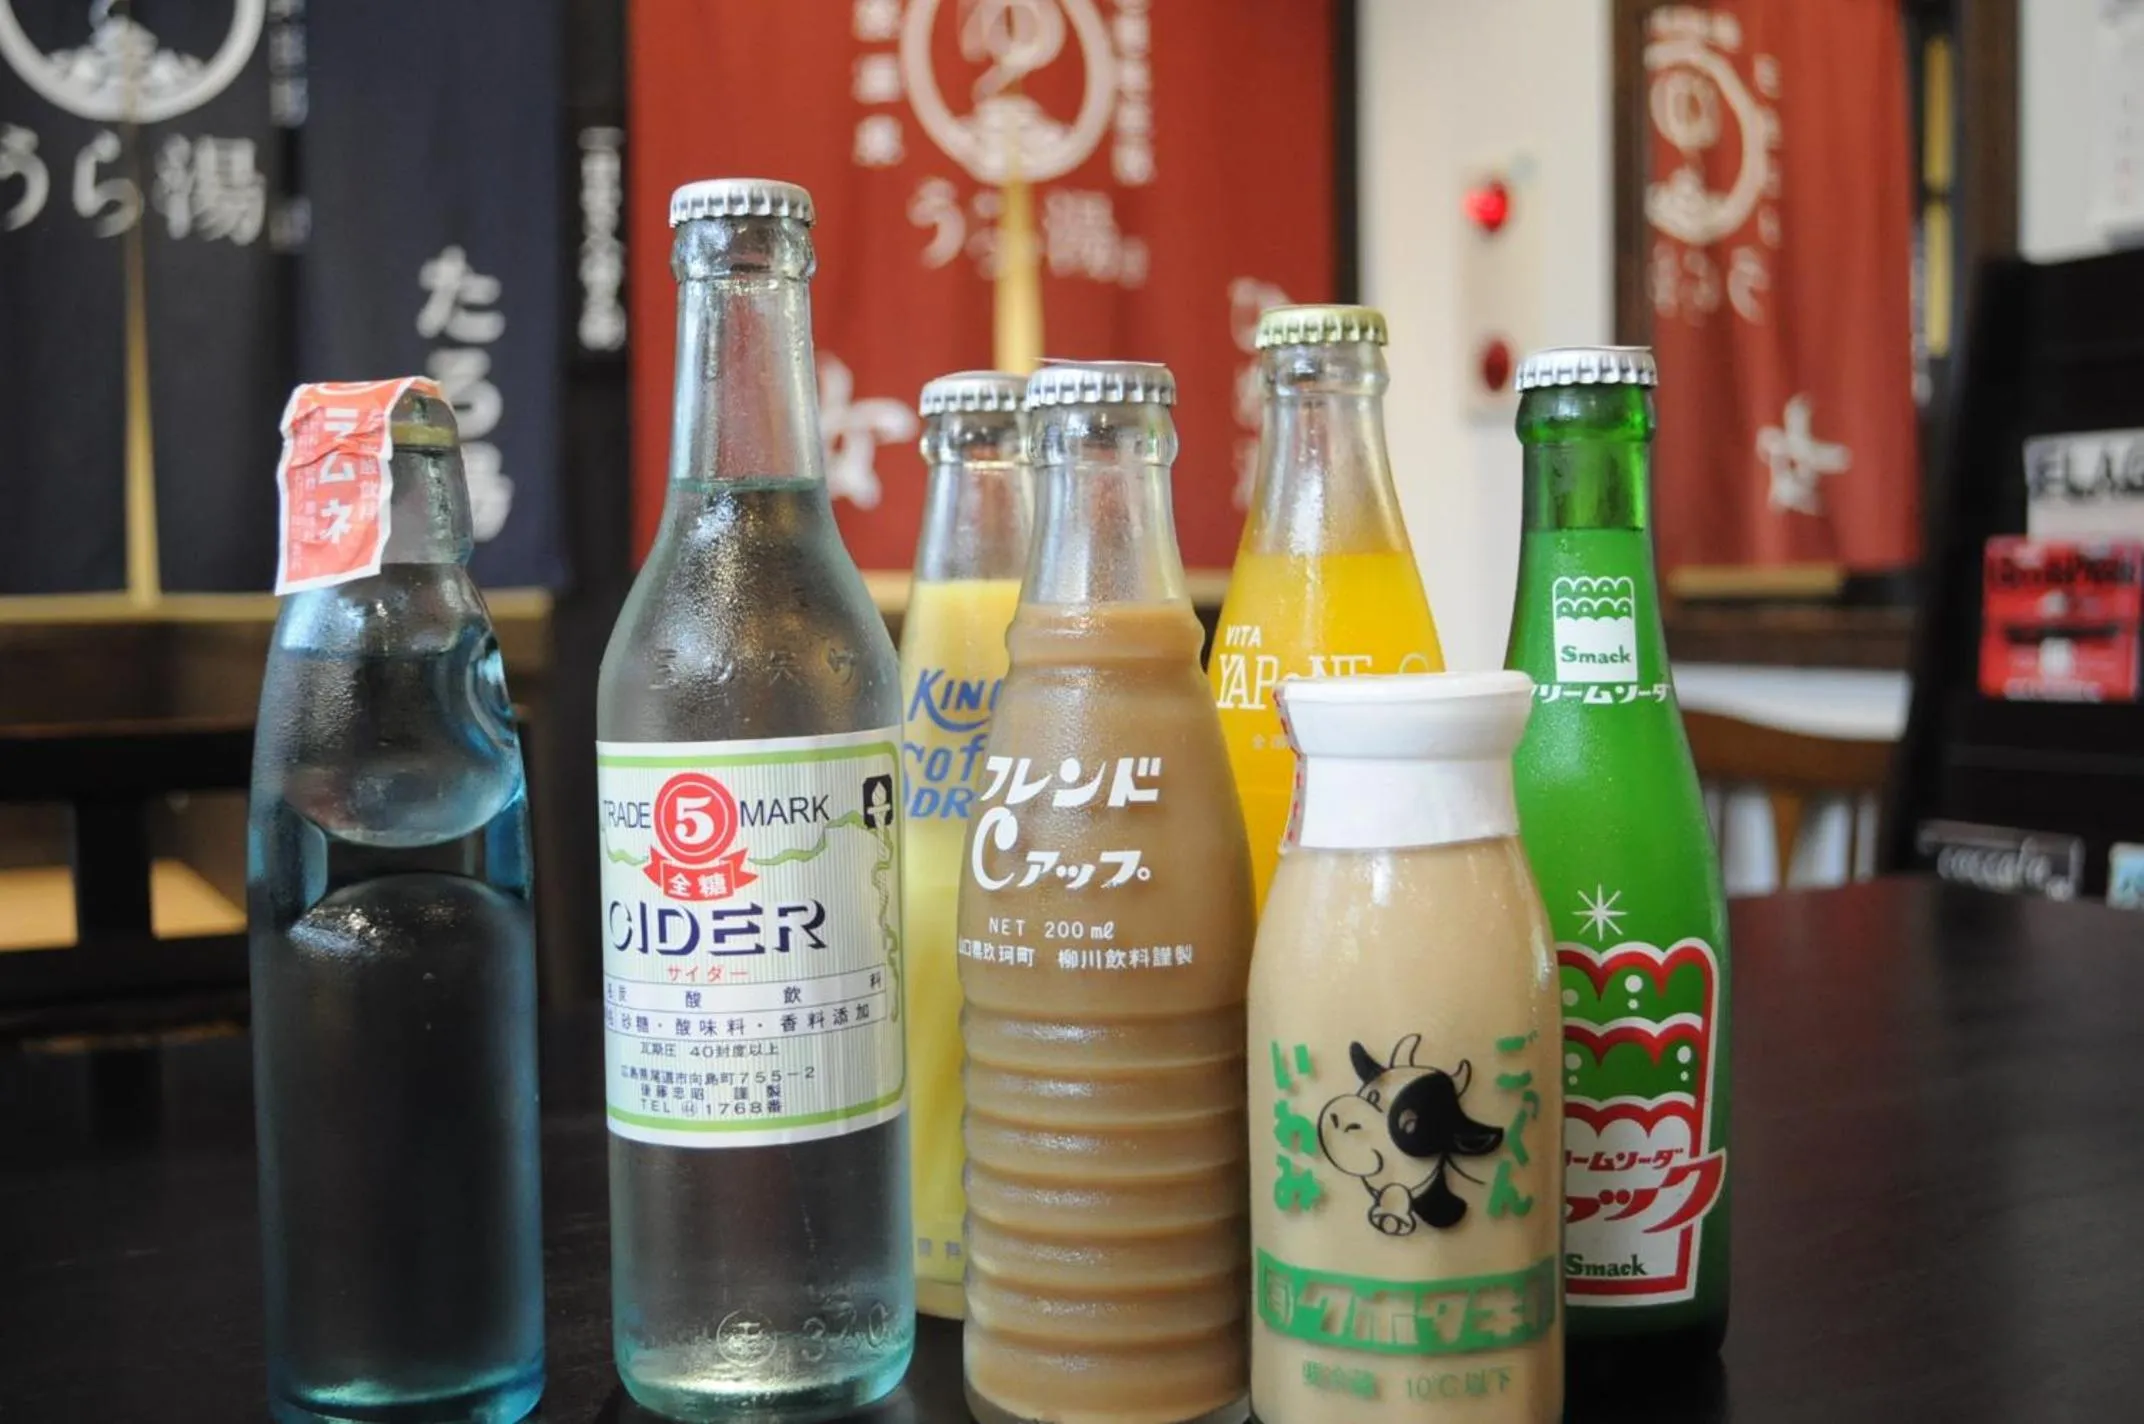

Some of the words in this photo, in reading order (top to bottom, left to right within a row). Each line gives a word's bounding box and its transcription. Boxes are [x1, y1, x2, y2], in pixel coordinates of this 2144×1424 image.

[319, 408, 360, 544] ラムネ
[1225, 624, 1262, 647] VITA
[1560, 645, 1632, 664] Smack
[1216, 653, 1373, 709] YAP
[903, 734, 989, 807] Cof
[979, 756, 1162, 808] フレンド
[909, 787, 976, 819] DR
[604, 800, 651, 829] TRADE
[675, 796, 715, 845] 5
[740, 794, 831, 828] MARK
[609, 899, 827, 956] CIDER
[988, 917, 1026, 937] NET
[667, 964, 749, 983] サイダー
[641, 1099, 671, 1114] TEL
[1564, 1252, 1649, 1277] Smack
